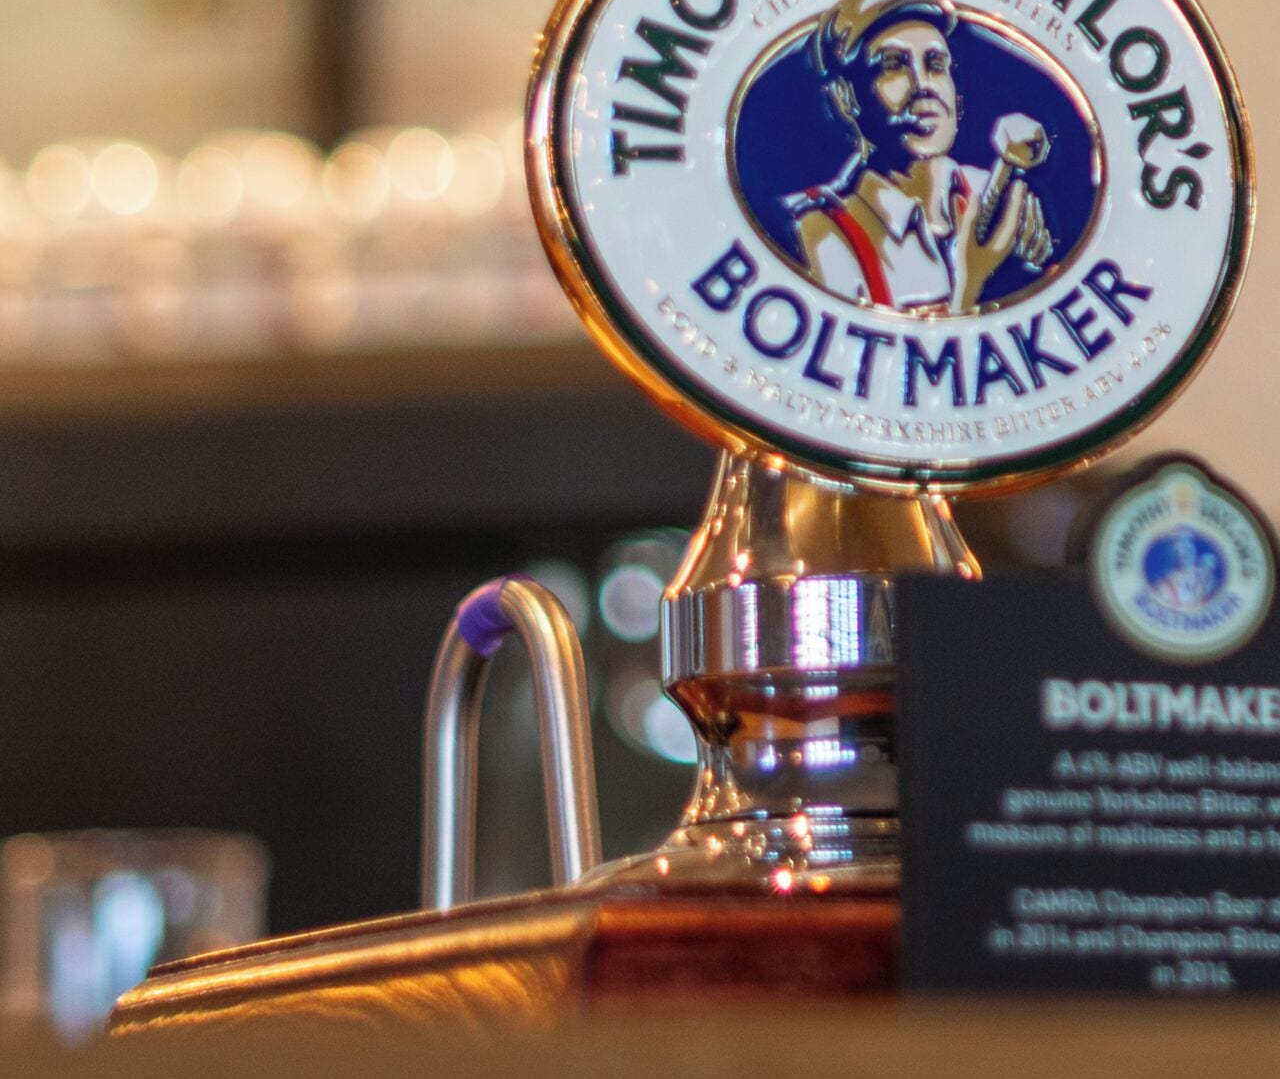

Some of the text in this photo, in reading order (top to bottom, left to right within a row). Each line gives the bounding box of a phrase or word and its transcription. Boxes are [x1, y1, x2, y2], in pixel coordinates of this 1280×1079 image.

[691, 239, 1154, 407] BOLTMAKER
[839, 407, 987, 444] YORKSHIRE
[993, 395, 1077, 437] BITTER
[1083, 368, 1125, 405] ABV
[1013, 887, 1099, 916] CAMRA
[1101, 889, 1209, 923] Champion
[1211, 891, 1265, 919] Beer
[1118, 924, 1225, 957] Champion
